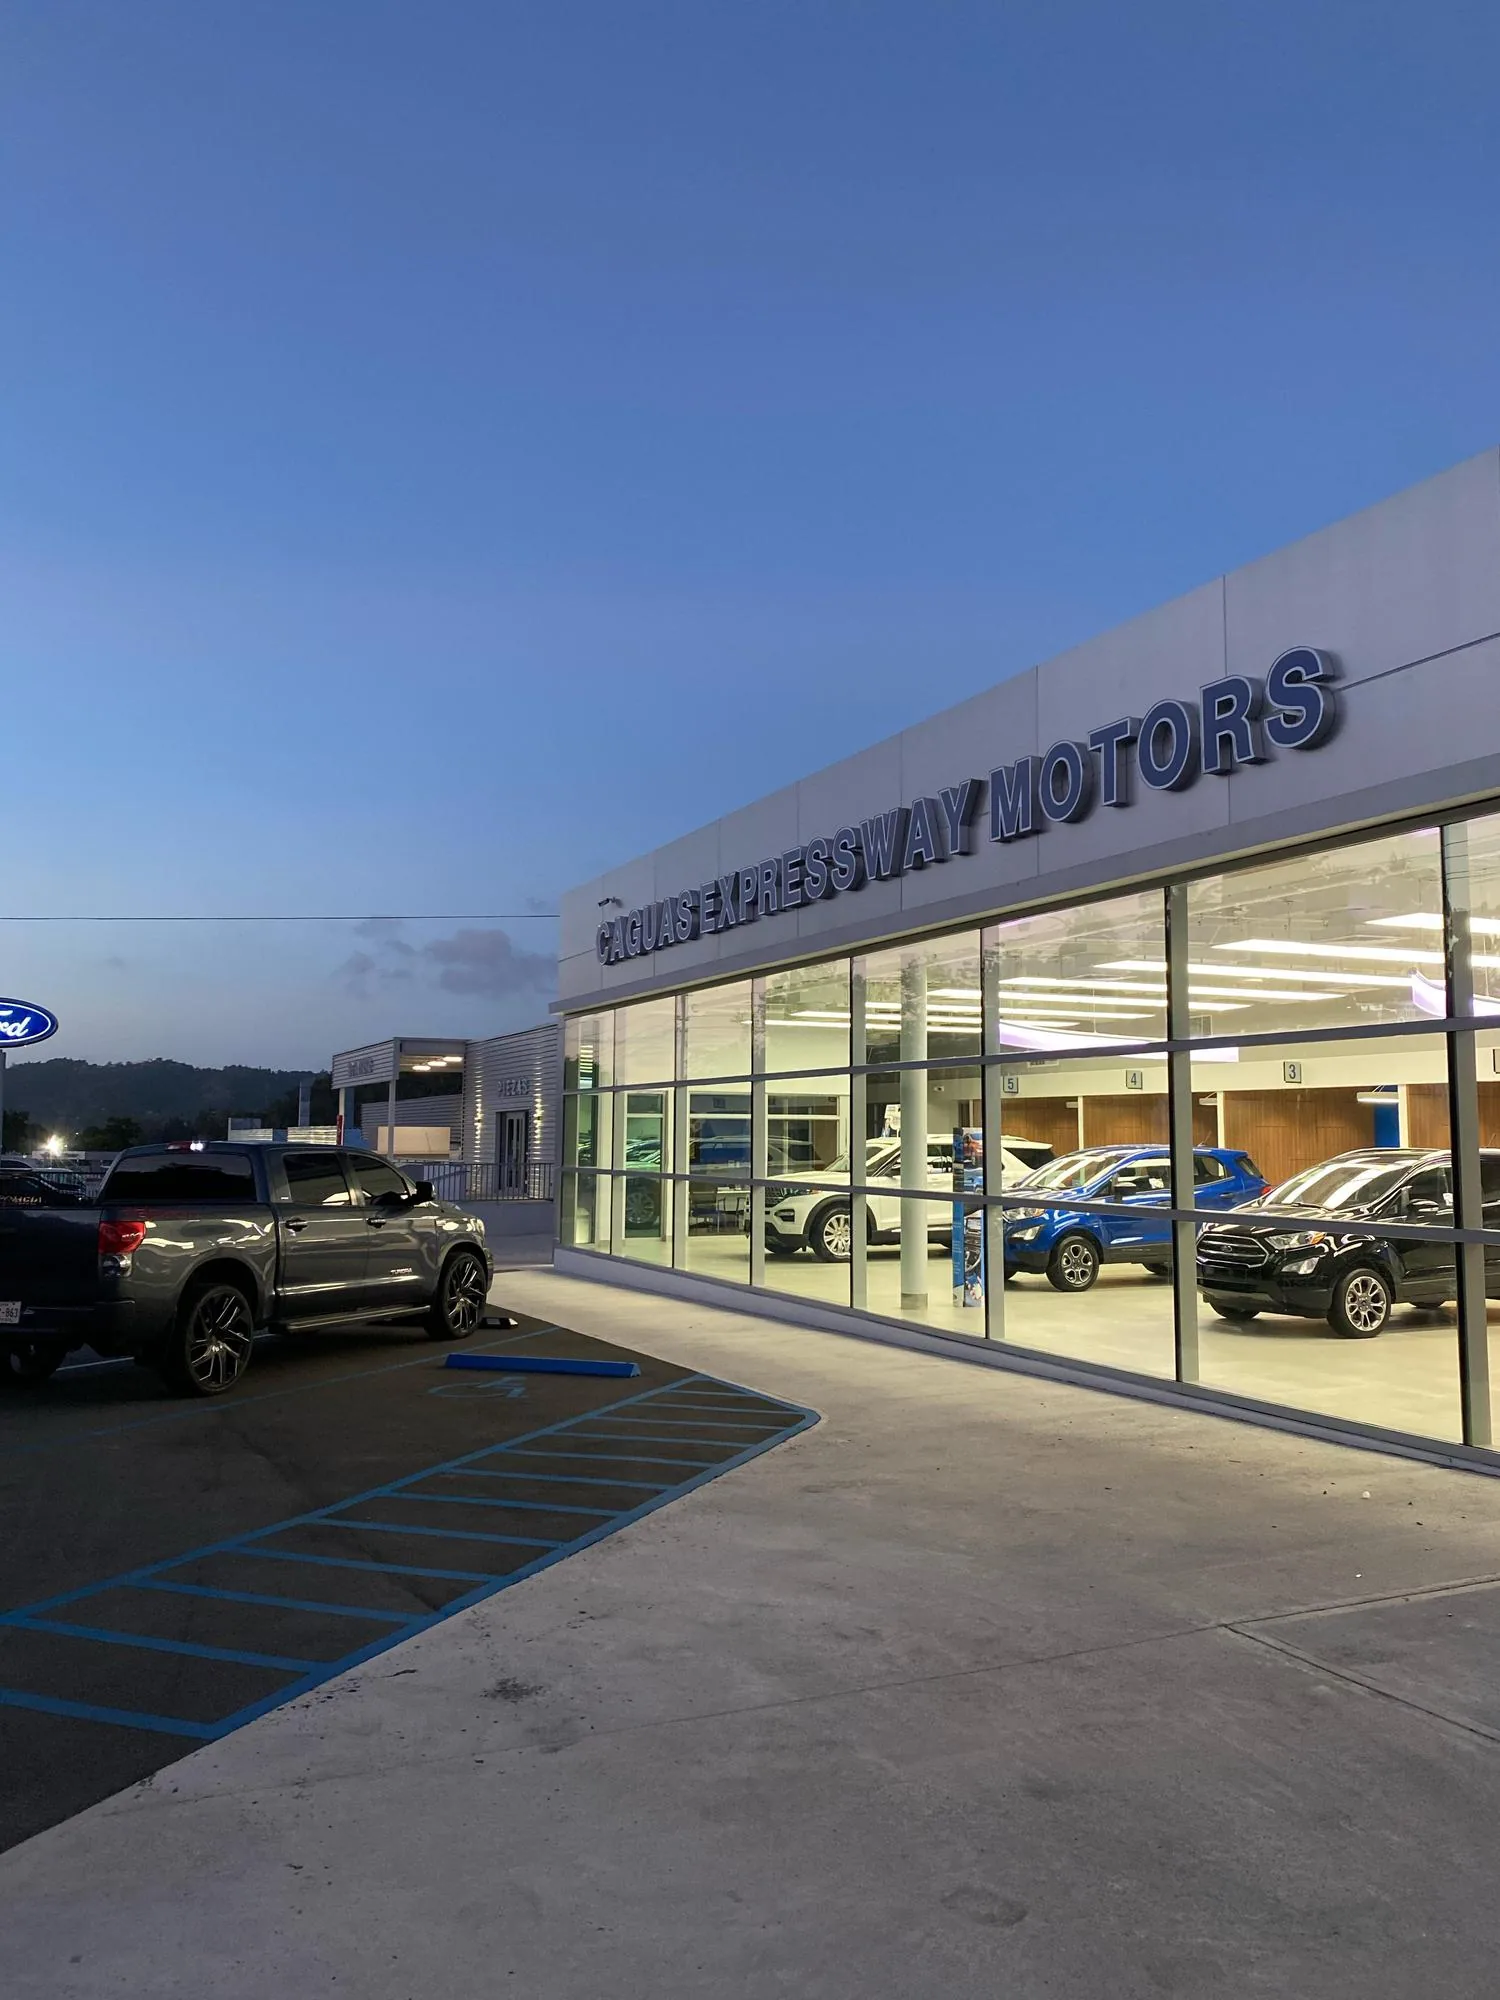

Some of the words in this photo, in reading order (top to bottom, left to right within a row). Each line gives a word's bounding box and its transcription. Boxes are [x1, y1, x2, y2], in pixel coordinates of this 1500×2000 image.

[596, 889, 699, 966] CAGUAS
[699, 777, 983, 935] EXPRESSWAY
[989, 645, 1338, 842] MOTORS
[0, 1009, 32, 1037] rd
[1130, 1072, 1138, 1086] 4
[1288, 1064, 1297, 1080] 3
[1007, 1077, 1015, 1090] 5
